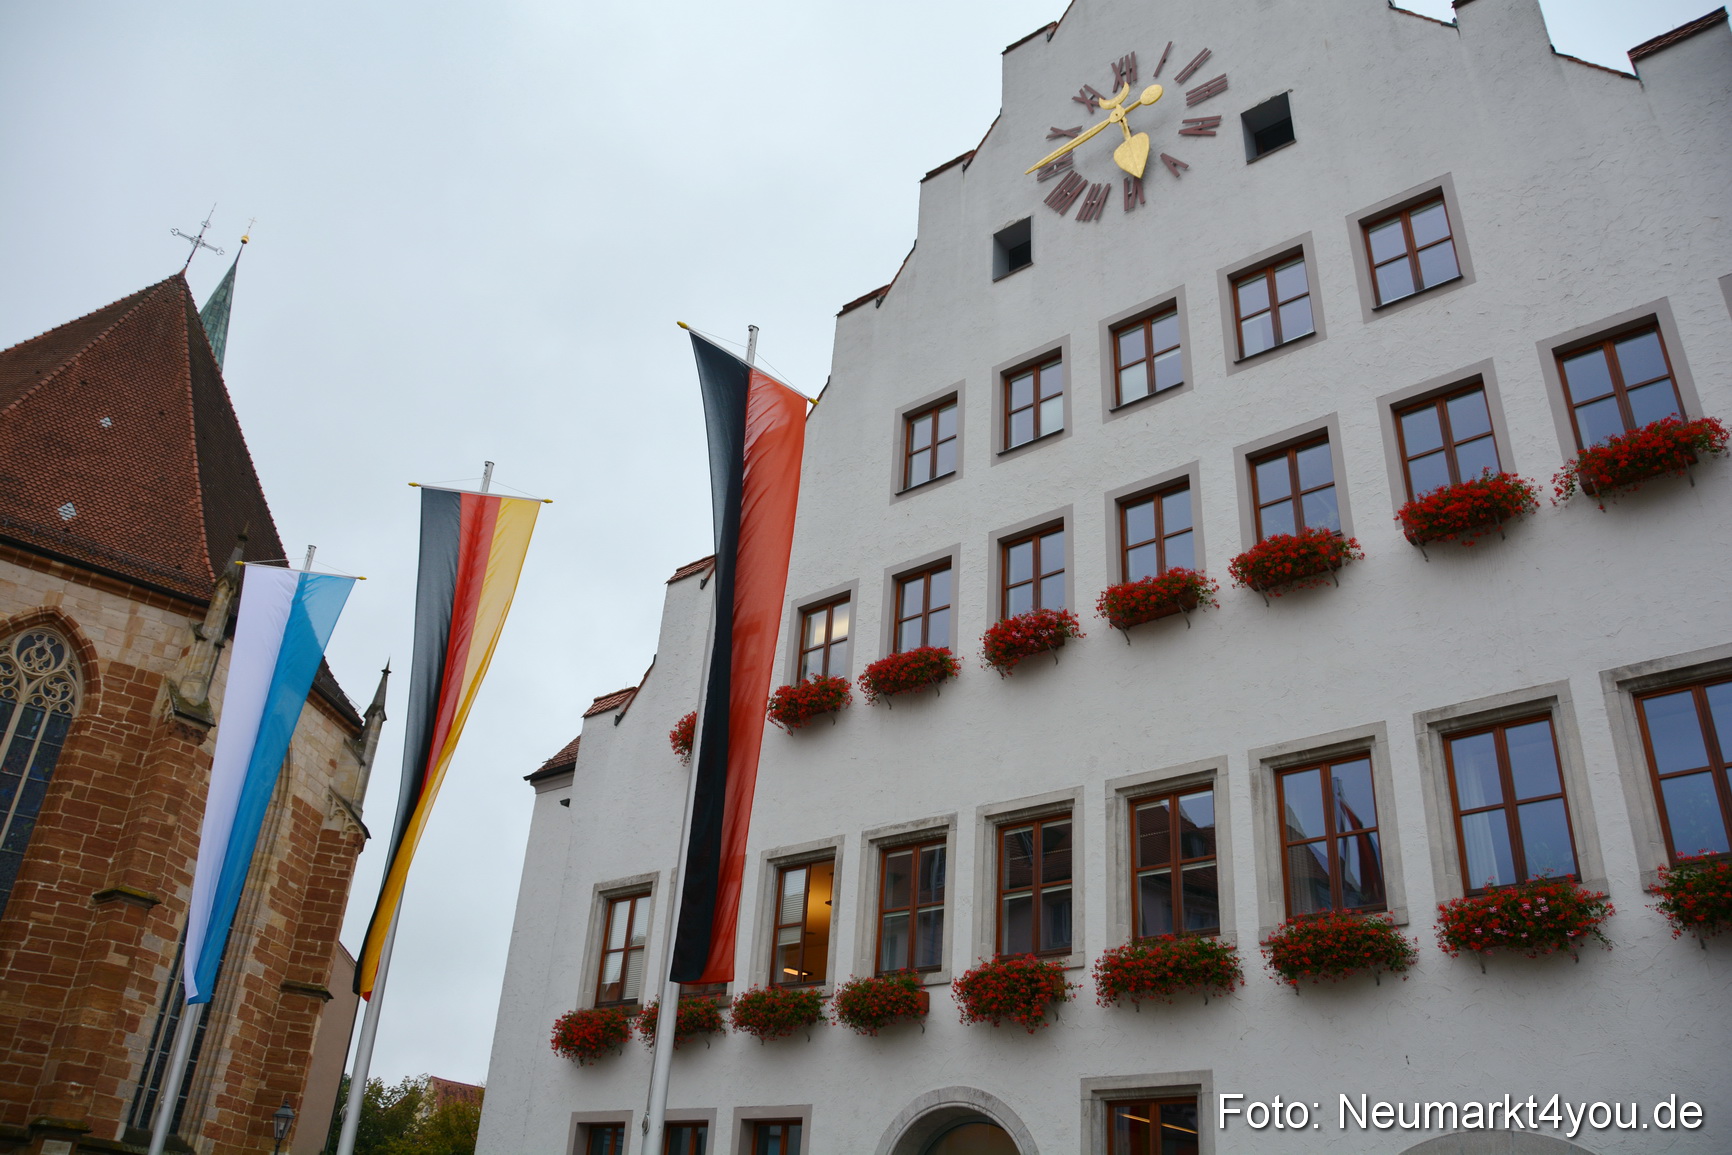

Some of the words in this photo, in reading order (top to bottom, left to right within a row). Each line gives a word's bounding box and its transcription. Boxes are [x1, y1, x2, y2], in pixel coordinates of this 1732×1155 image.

[1111, 51, 1138, 93] XII
[1174, 47, 1212, 84] II
[1185, 73, 1228, 107] III
